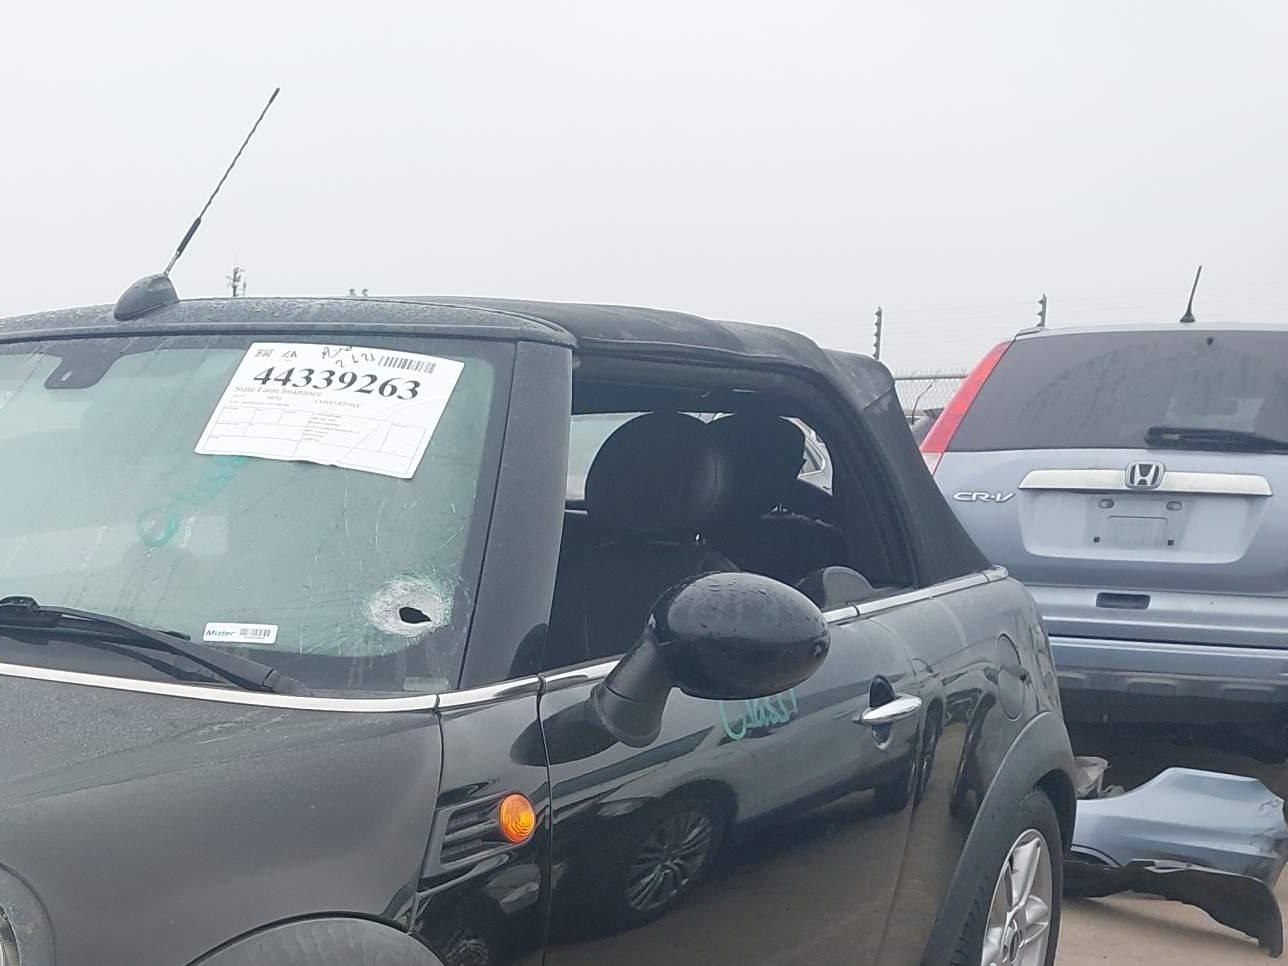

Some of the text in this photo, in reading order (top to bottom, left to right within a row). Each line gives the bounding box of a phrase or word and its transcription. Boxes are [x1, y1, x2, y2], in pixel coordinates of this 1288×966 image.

[235, 385, 256, 393] State
[257, 386, 279, 394] Farm
[253, 366, 421, 400] 44339263
